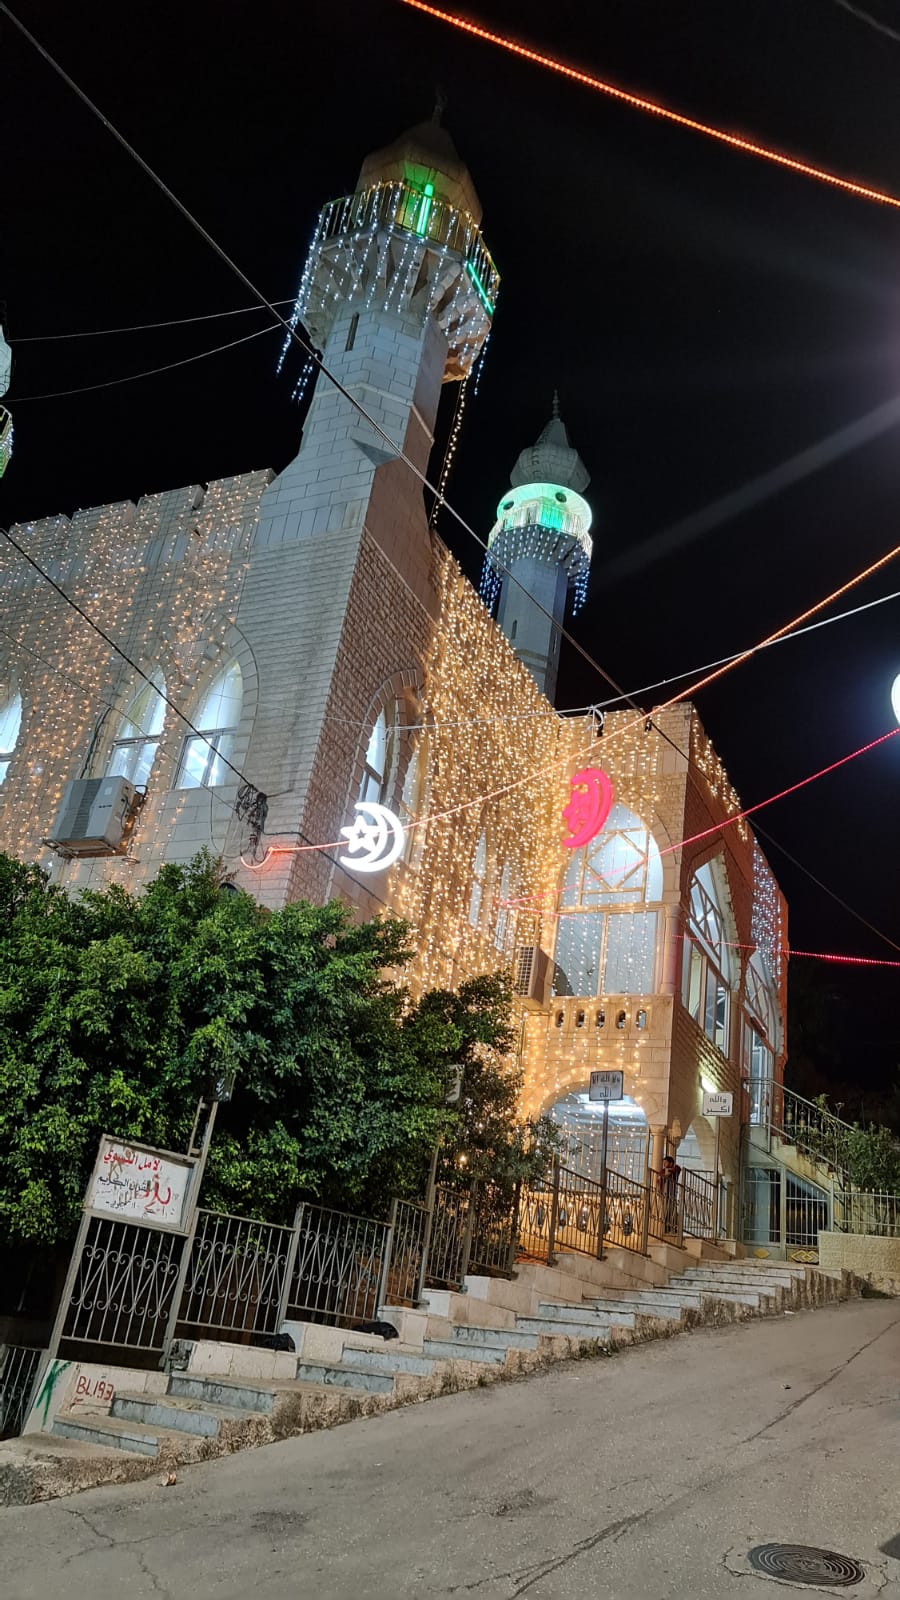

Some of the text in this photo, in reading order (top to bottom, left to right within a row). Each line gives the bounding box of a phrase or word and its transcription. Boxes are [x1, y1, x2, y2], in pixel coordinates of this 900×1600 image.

[599, 1087, 612, 1098] الله
[709, 1096, 727, 1105] والله
[706, 1105, 730, 1115] اكبر
